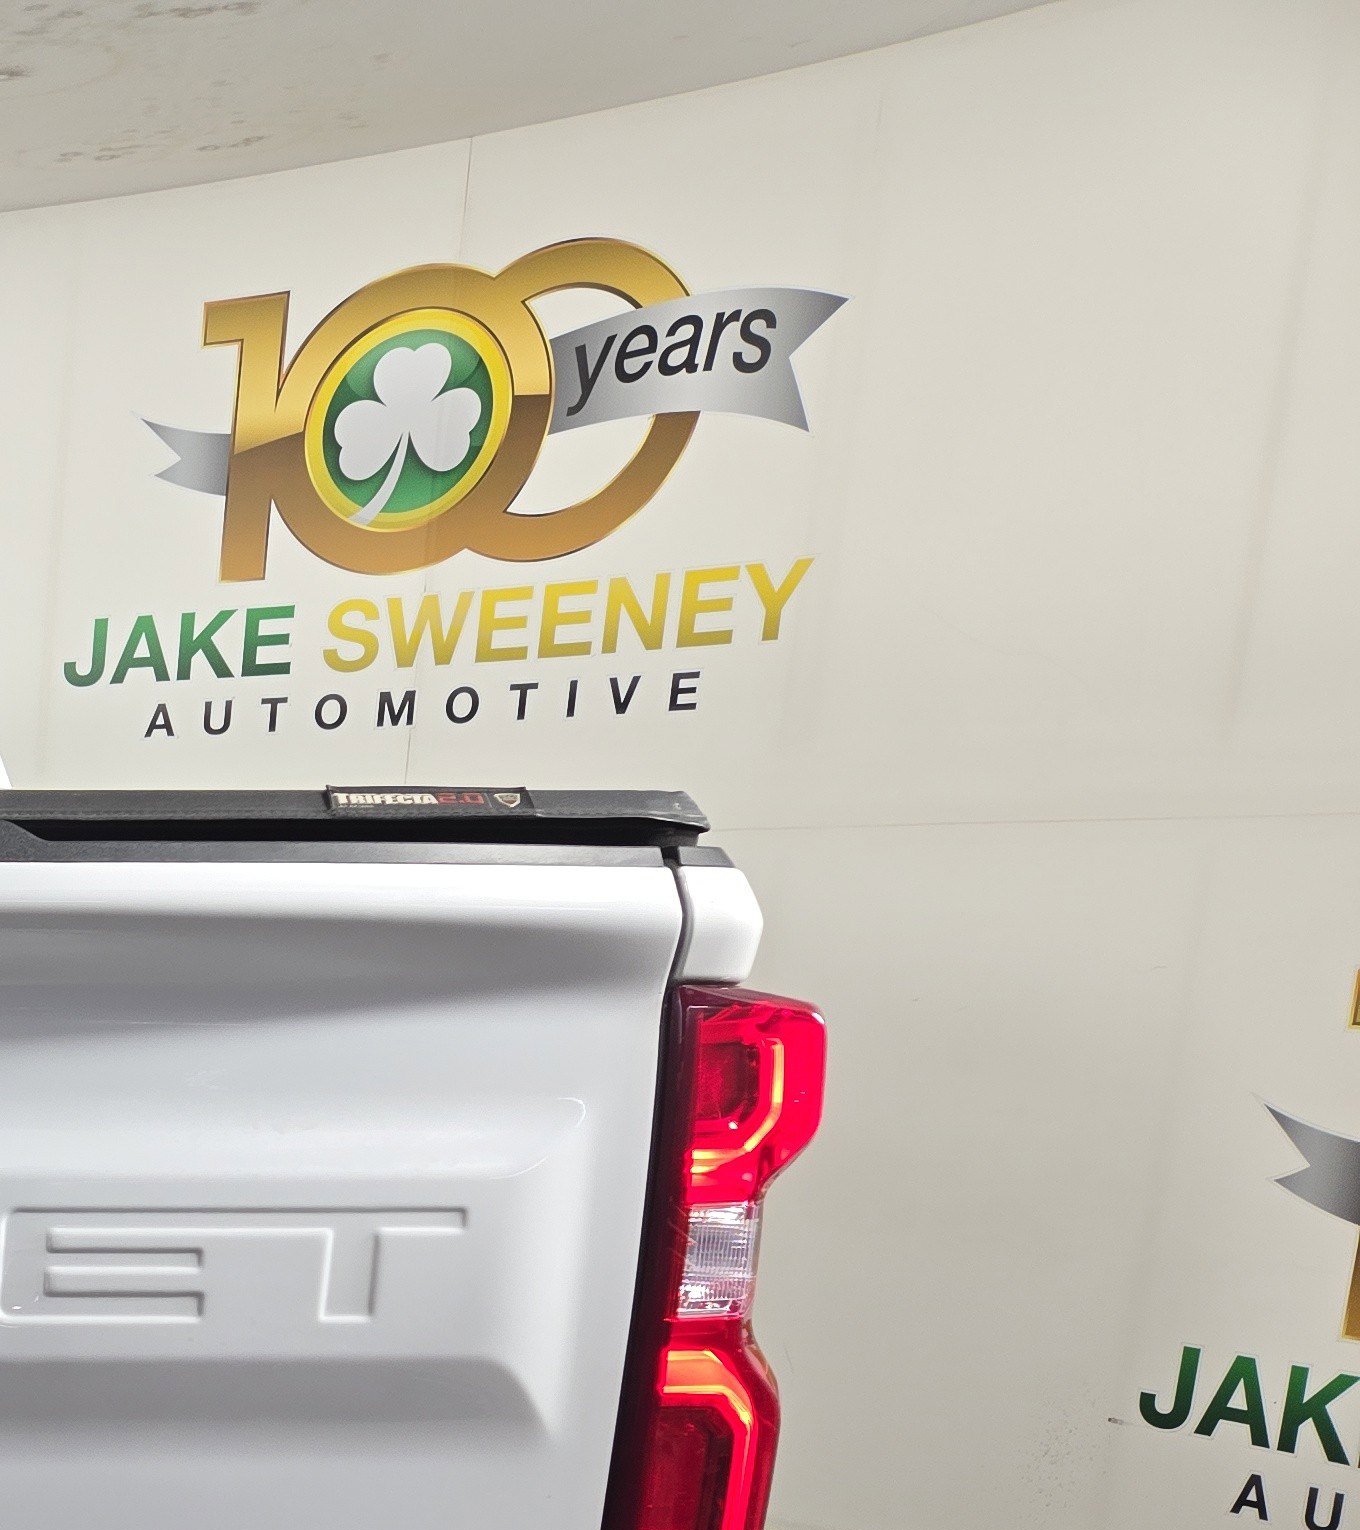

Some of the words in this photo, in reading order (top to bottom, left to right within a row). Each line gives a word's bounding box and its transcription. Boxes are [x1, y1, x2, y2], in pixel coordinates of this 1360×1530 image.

[566, 307, 778, 417] years
[64, 605, 296, 689] JAKE
[323, 558, 815, 673] SWEENEY
[145, 671, 702, 739] AUTOMOTIVE
[1140, 1345, 1360, 1469] JAK
